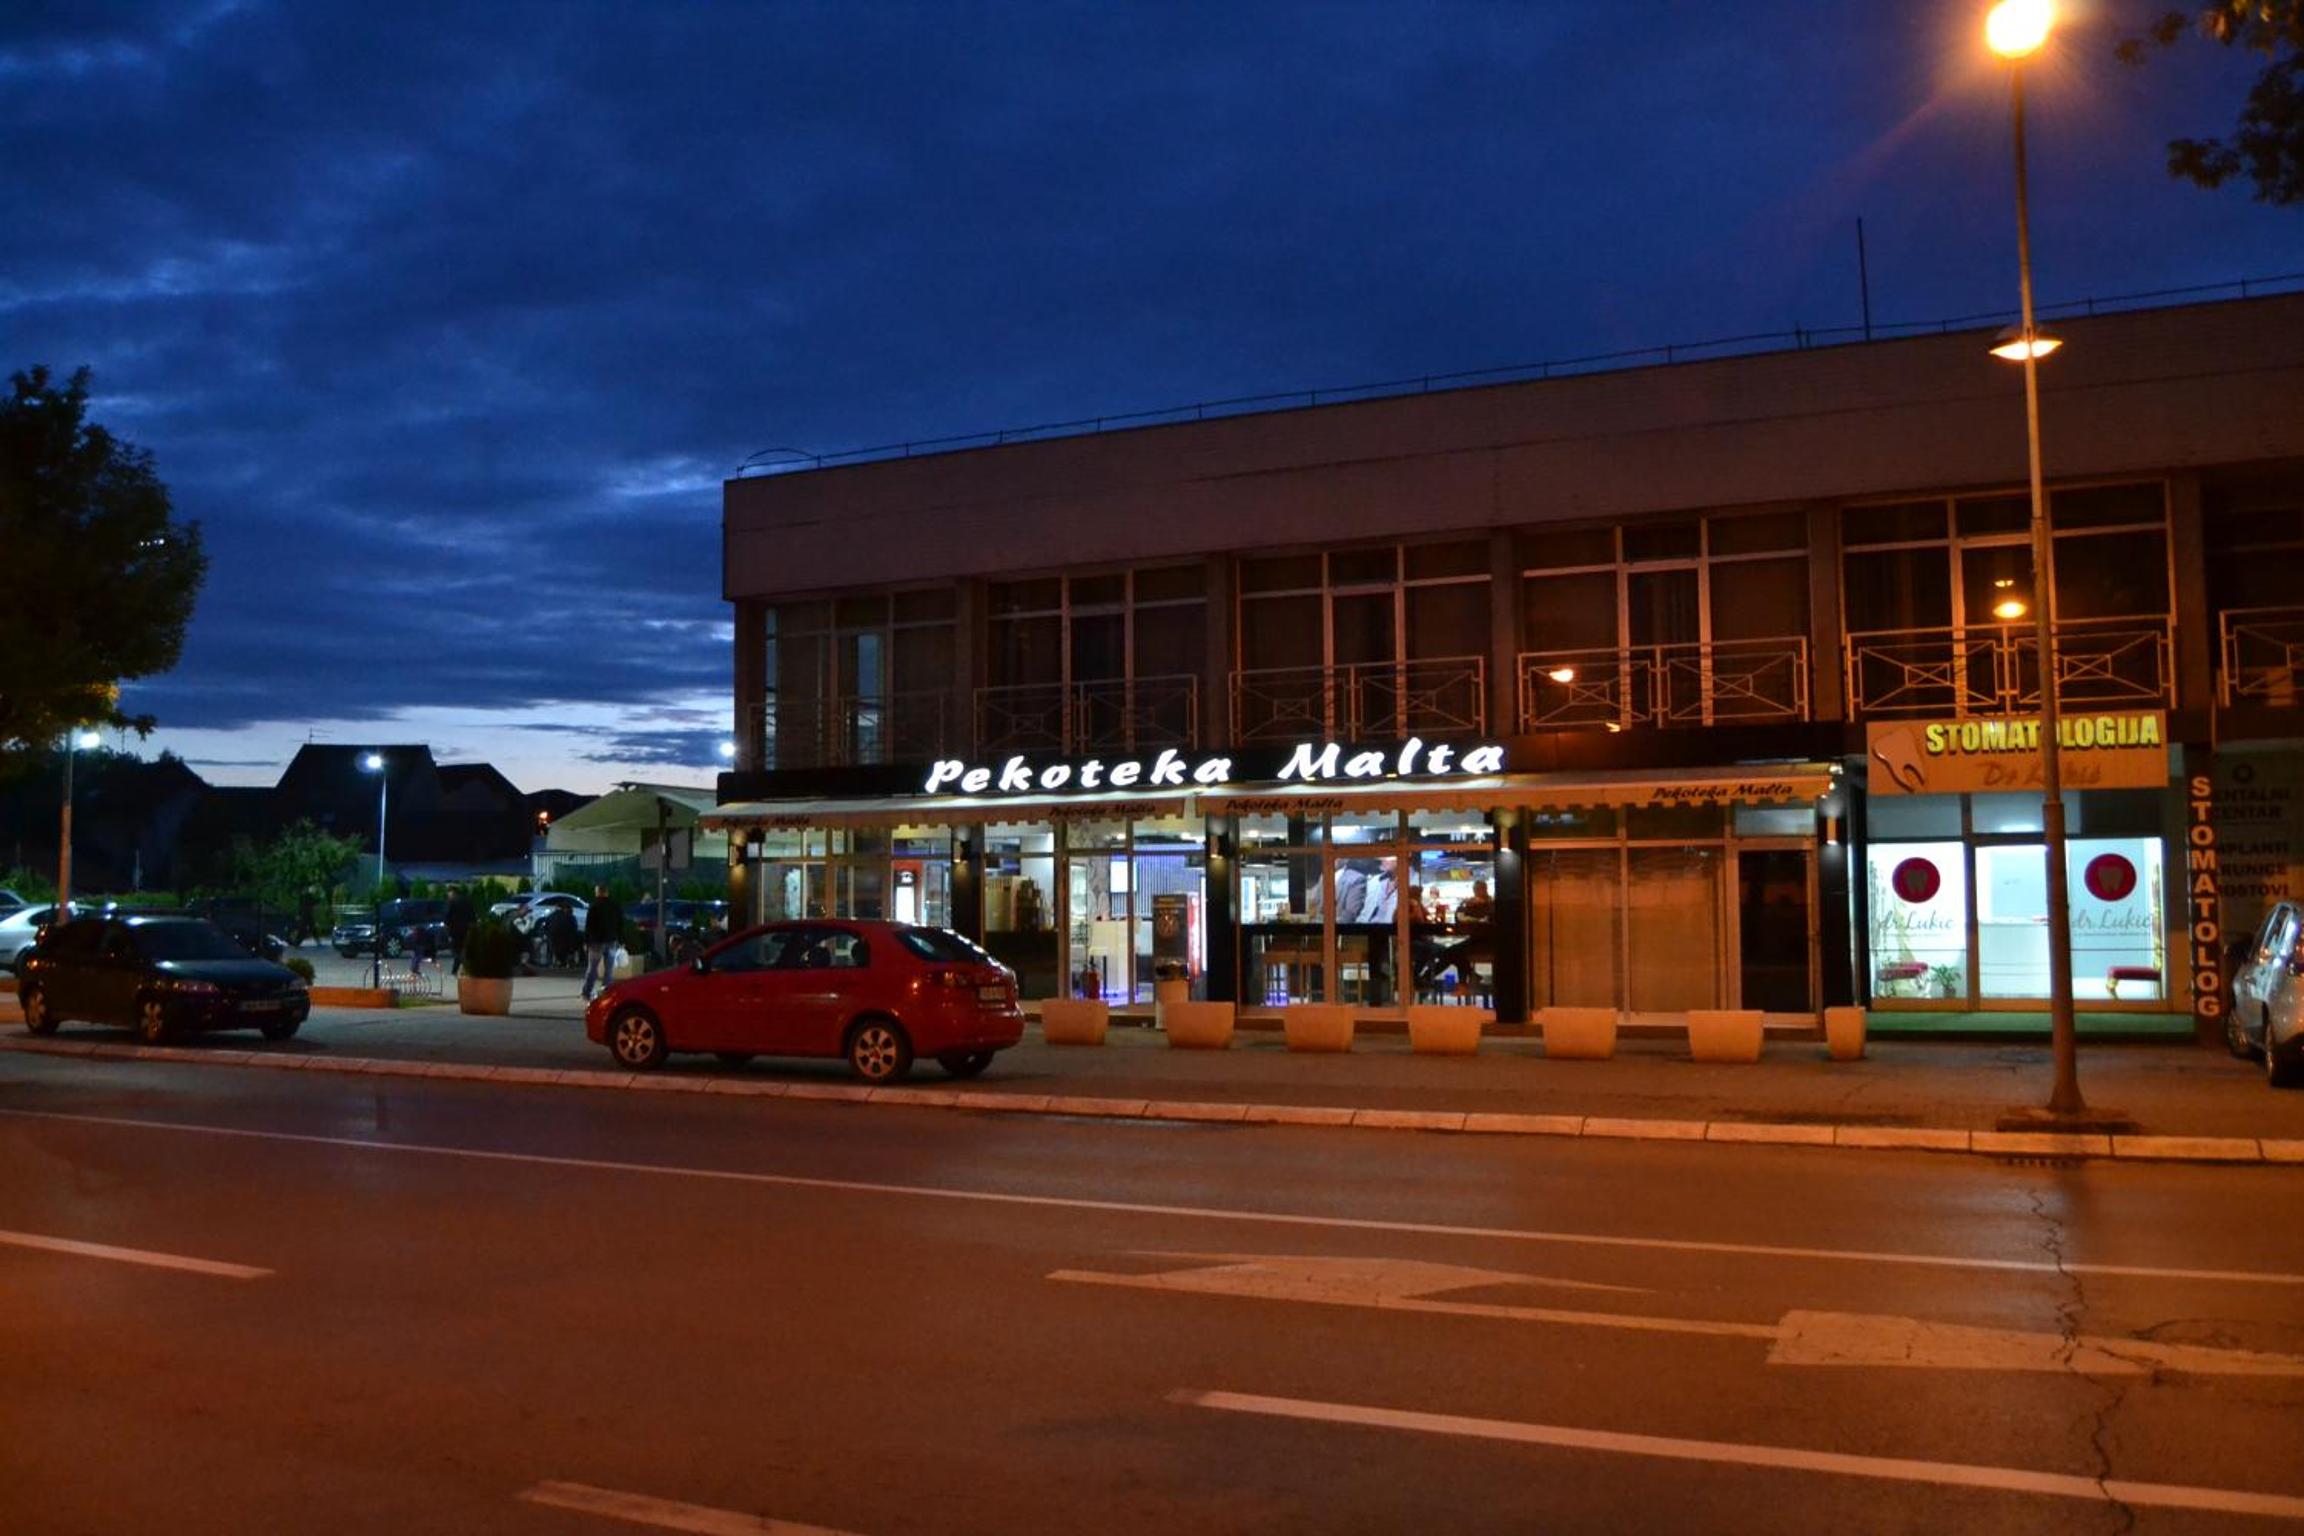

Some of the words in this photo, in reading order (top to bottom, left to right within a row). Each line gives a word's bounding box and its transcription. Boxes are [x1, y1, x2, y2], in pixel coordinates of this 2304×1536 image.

[1926, 715, 2161, 753] STOMATLOGIJA
[924, 749, 1232, 794] Pekoteka
[1277, 736, 1504, 780] Malta
[1732, 783, 1793, 797] Malta
[2190, 777, 2221, 1017] STOMATOLOG
